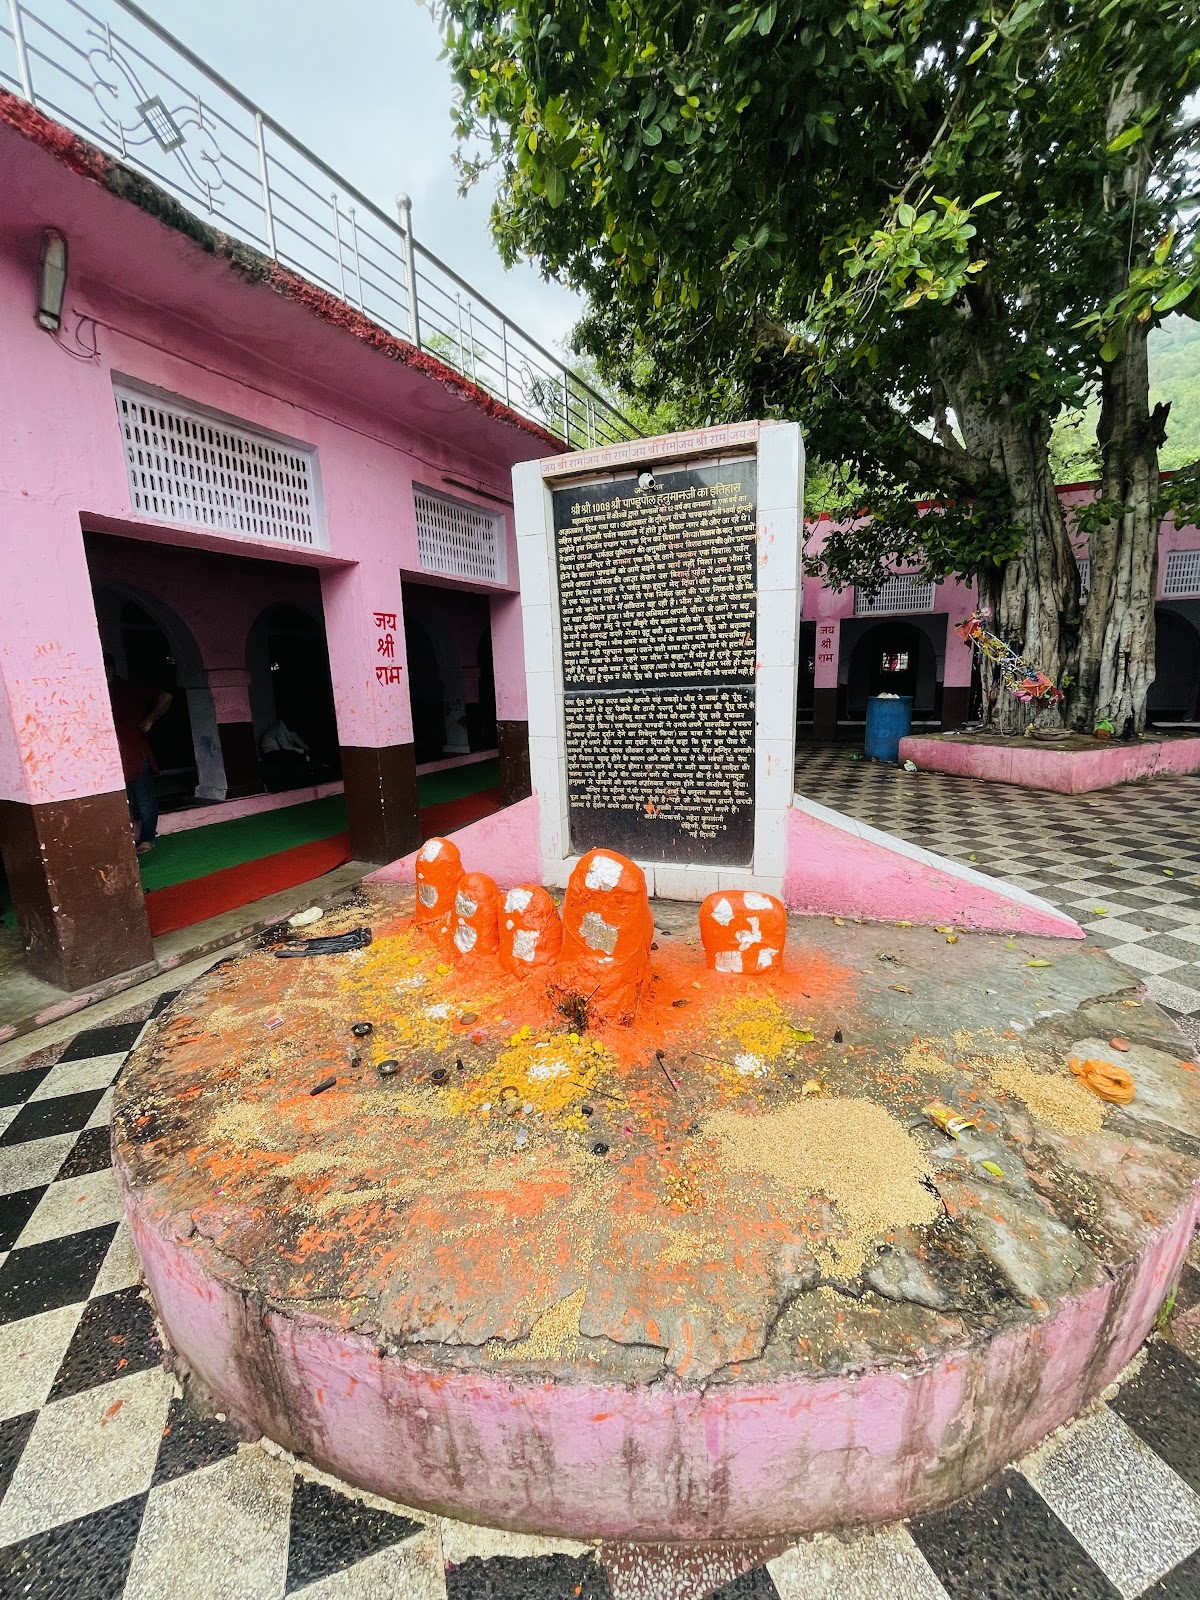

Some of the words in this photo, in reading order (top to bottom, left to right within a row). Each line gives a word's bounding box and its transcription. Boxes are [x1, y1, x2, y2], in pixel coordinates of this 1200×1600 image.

[542, 464, 555, 473] जय
[558, 459, 567, 470] श्री
[569, 458, 584, 469] राम
[584, 456, 599, 464] जय
[601, 450, 611, 462] श्री
[613, 450, 628, 460] राम
[631, 446, 646, 456] जय
[648, 441, 659, 454] श्री
[662, 442, 676, 452] राम
[679, 438, 694, 449] जय
[696, 434, 708, 446] श्री
[710, 434, 726, 444] राम
[730, 430, 746, 440] जय
[748, 426, 759, 438] श्री
[570, 502, 580, 514] श्री
[581, 501, 591, 513] श्री
[592, 501, 610, 511] 1008
[611, 496, 620, 509] श्री
[656, 486, 695, 504] हनुमानजी
[697, 487, 708, 496] का
[710, 482, 741, 497] इतिहास
[373, 612, 397, 631] जय
[820, 626, 835, 634] जय
[377, 633, 395, 658] श्री
[821, 637, 832, 649] श्री
[818, 653, 834, 662] राम
[375, 666, 402, 687] राम
